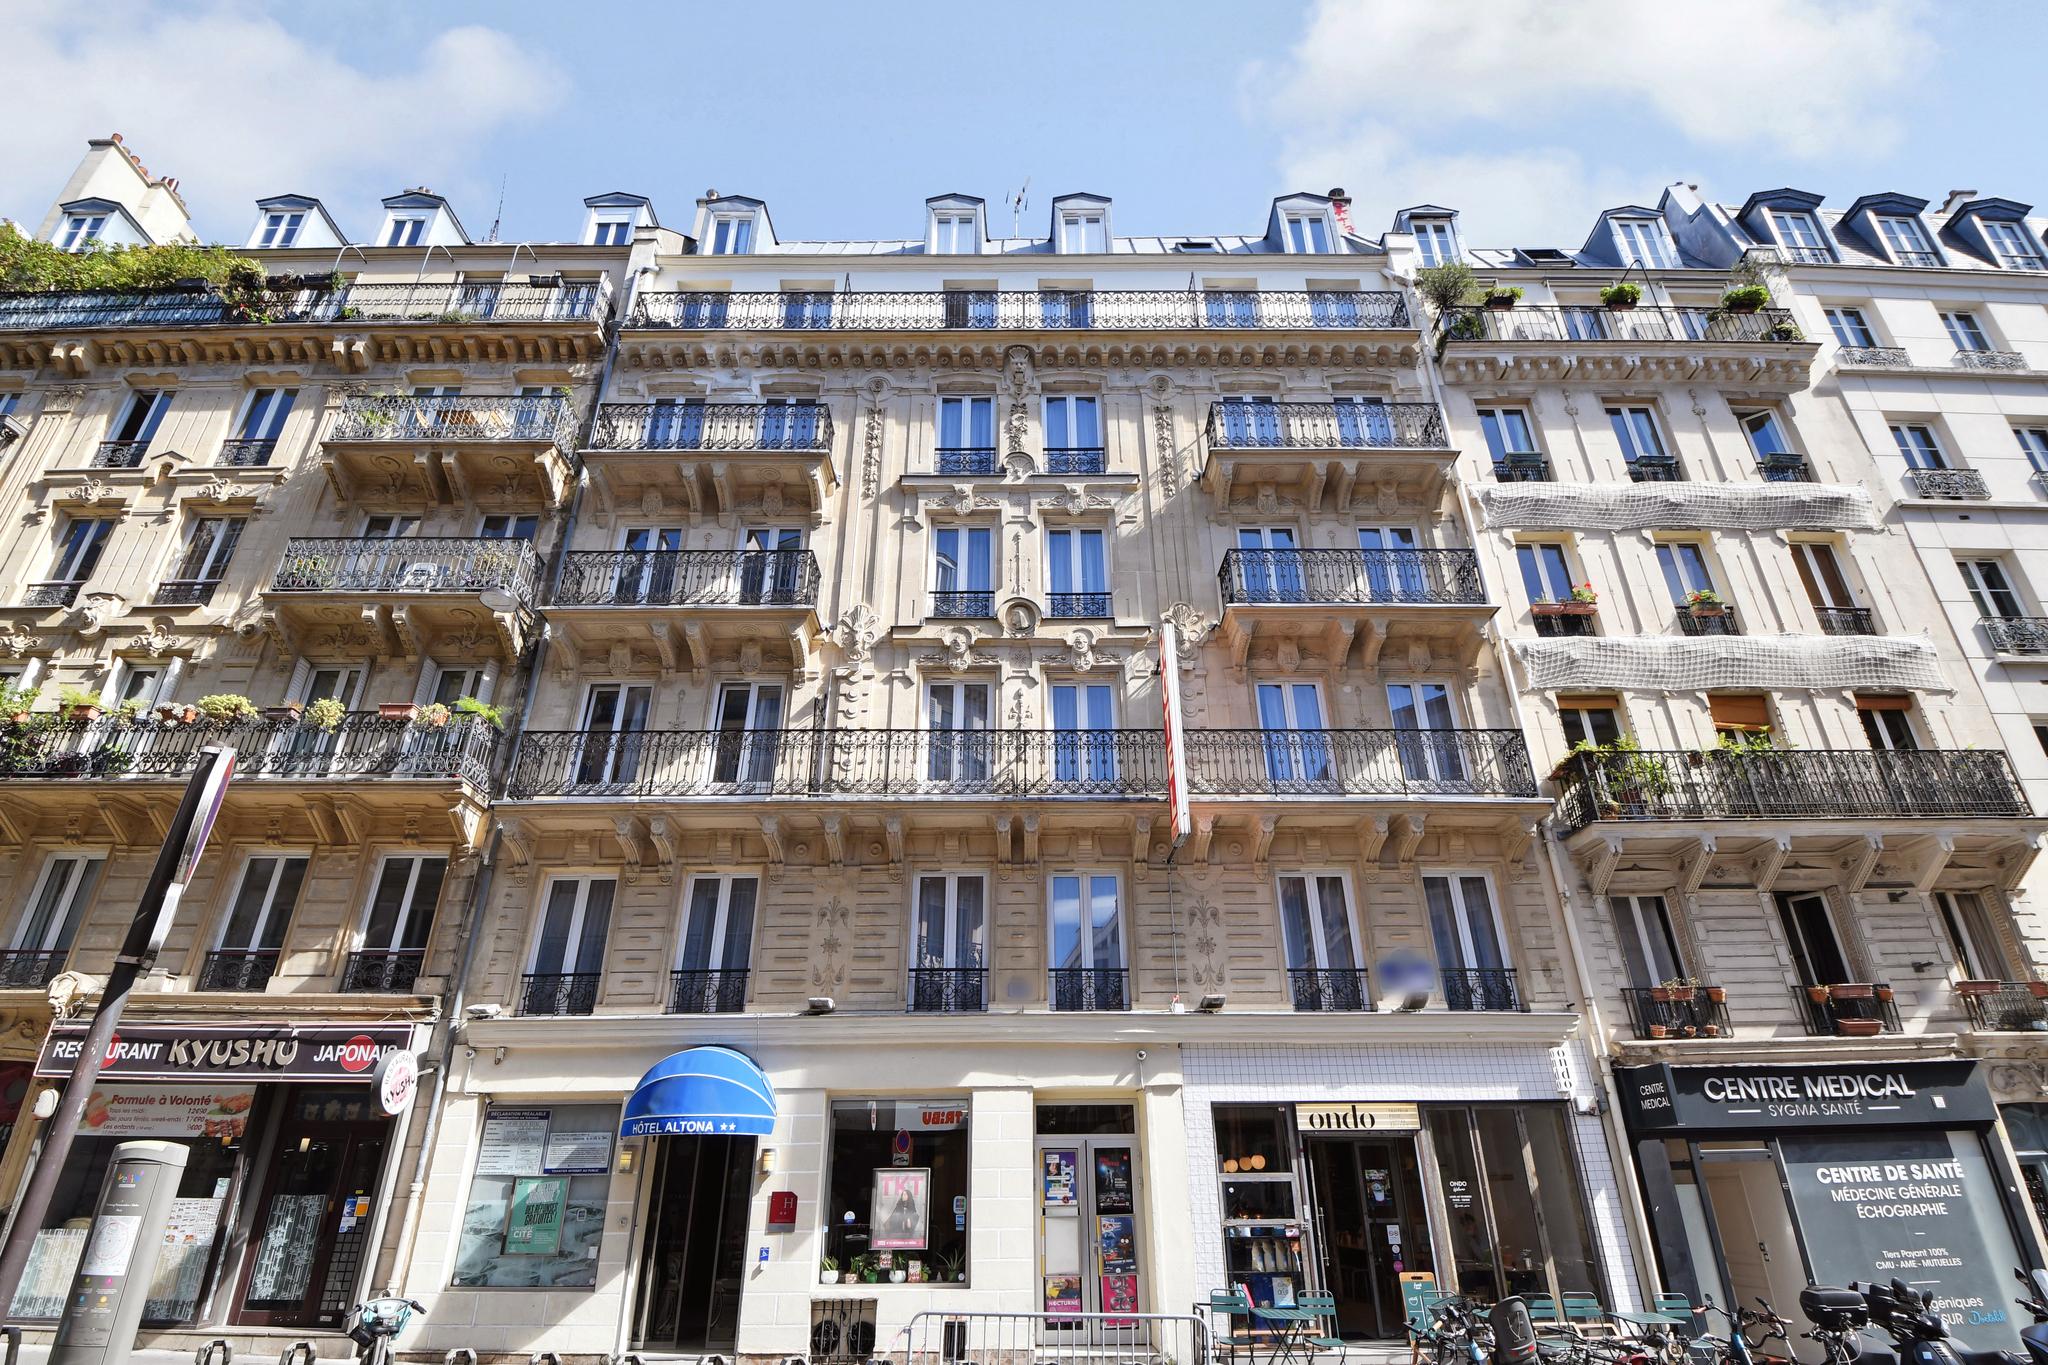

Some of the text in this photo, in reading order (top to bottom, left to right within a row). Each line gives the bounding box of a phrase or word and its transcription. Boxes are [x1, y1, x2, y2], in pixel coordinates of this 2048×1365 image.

[168, 1038, 298, 1068] KYUSHU
[1557, 1050, 1572, 1089] ondo
[384, 1073, 416, 1105] KYUSHU
[1640, 1082, 1665, 1096] CENTRE
[1703, 1074, 1917, 1100] CENTRE MEDICAL
[111, 1094, 211, 1105] Formule à Volonté
[1640, 1097, 1671, 1110] MEDICAL
[1309, 1105, 1375, 1129] ondo
[1768, 1100, 1863, 1117] SYGMA SANTÉ
[632, 1120, 714, 1135] HÔTEL ALTONA
[1816, 1158, 1965, 1184] CENTRE DE SANTÉ
[880, 1175, 924, 1196] TKT
[1831, 1183, 1962, 1202] MÉDECINE GÉNÉRALE
[1856, 1203, 1948, 1219] ÉCHOGRAPHIE
[1882, 1248, 1949, 1260] Tiers Payant 100%
[1876, 1261, 1895, 1270] CMU
[1900, 1260, 1918, 1269] AME
[1921, 1257, 1963, 1268] MUTUELLES
[1920, 1296, 1984, 1312] géniques
